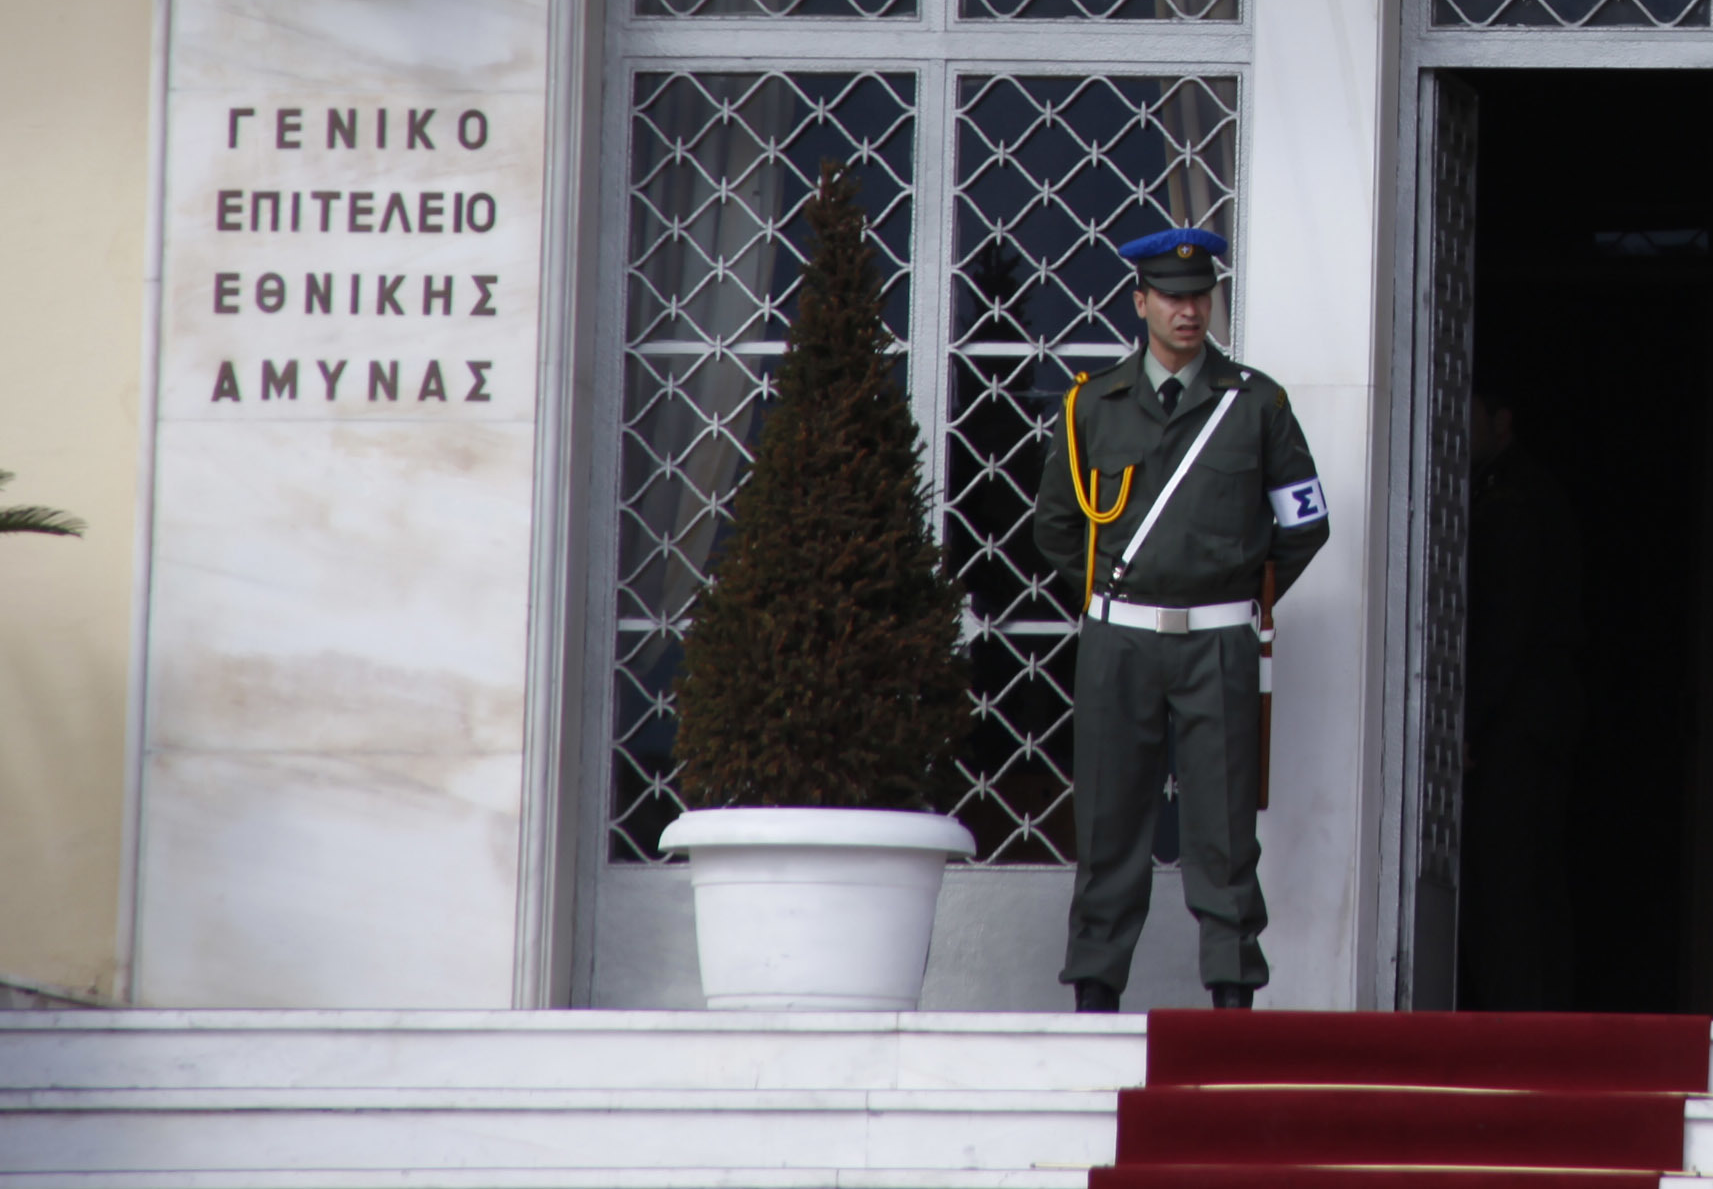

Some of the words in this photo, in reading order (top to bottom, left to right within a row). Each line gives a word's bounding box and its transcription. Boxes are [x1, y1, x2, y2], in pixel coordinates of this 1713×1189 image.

[228, 108, 489, 151] ΓΕΝΙΚΟ
[216, 190, 497, 234] ΕΠΙΤΕΛΕΙΟ
[213, 272, 498, 317] ΕΘΝΙΚΗΣ
[211, 359, 492, 403] ΑΜΥΝΑΣ
[1292, 479, 1327, 519] Σ
